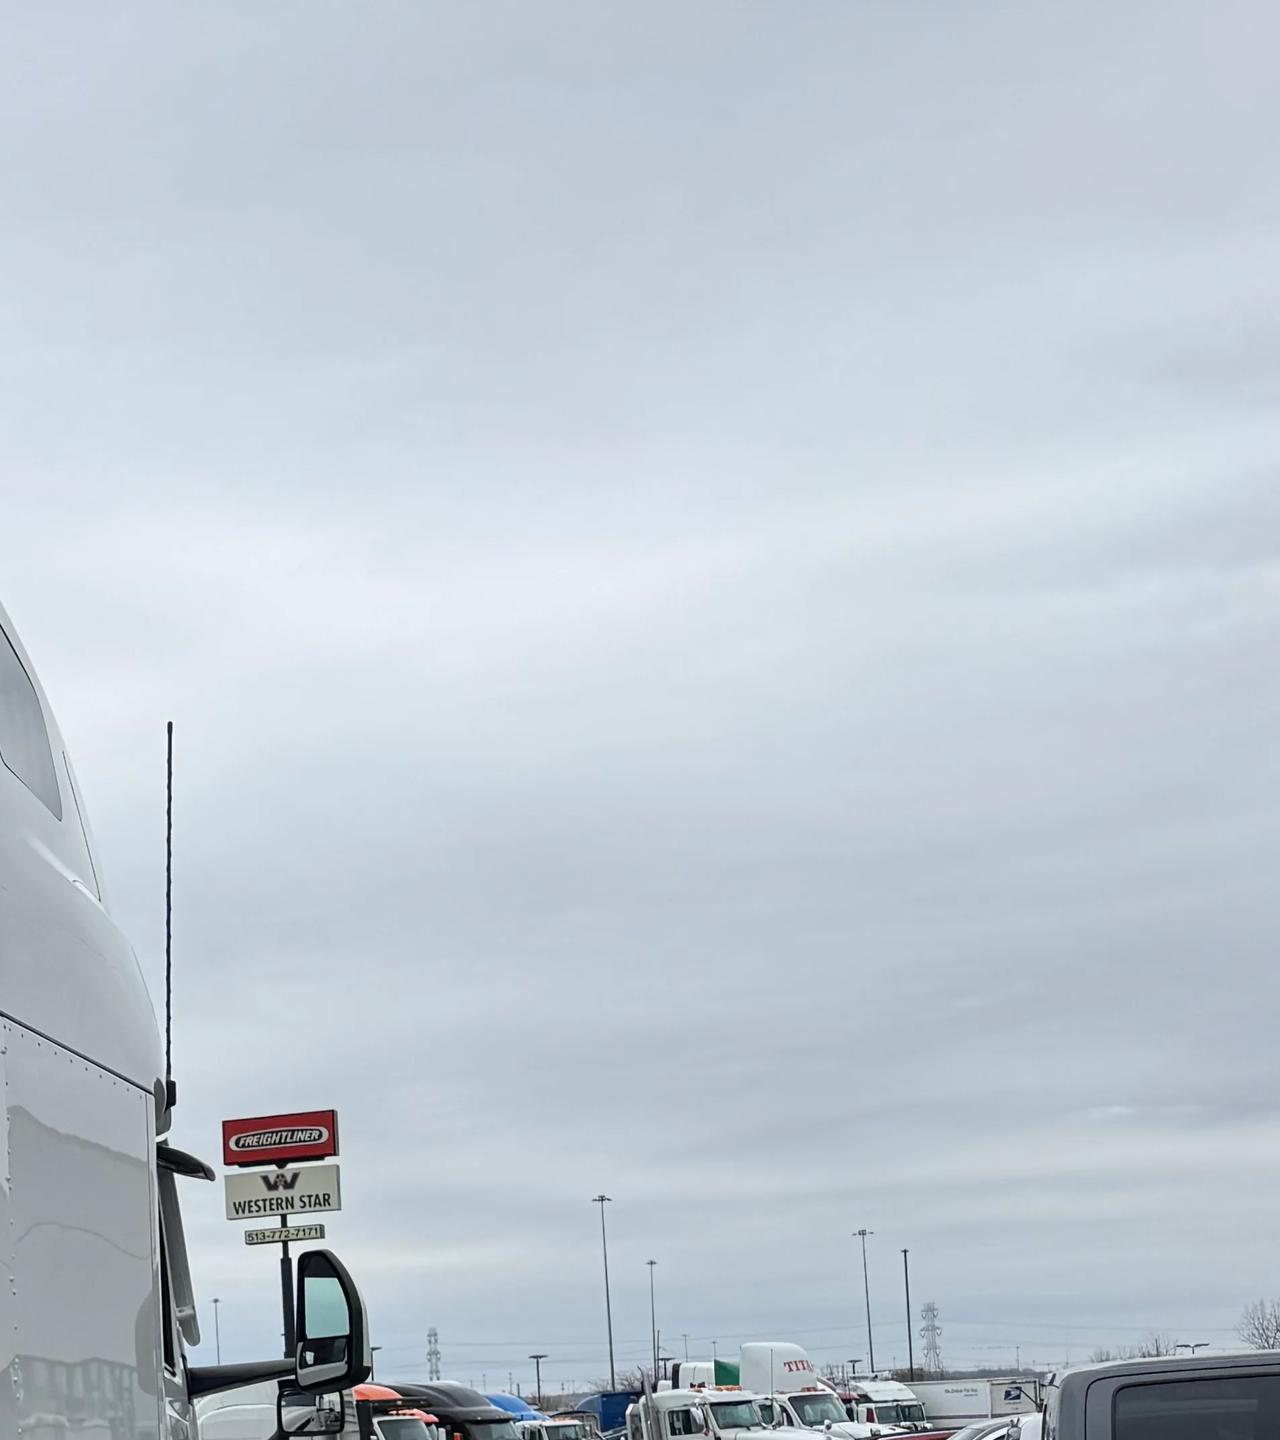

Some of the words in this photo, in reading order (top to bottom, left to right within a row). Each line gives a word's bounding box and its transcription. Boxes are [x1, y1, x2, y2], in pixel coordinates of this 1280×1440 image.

[238, 1130, 320, 1148] FREIGHTLINER
[233, 1196, 295, 1215] WESTERN
[300, 1193, 331, 1209] STAR
[247, 1227, 318, 1242] 513-772-7171
